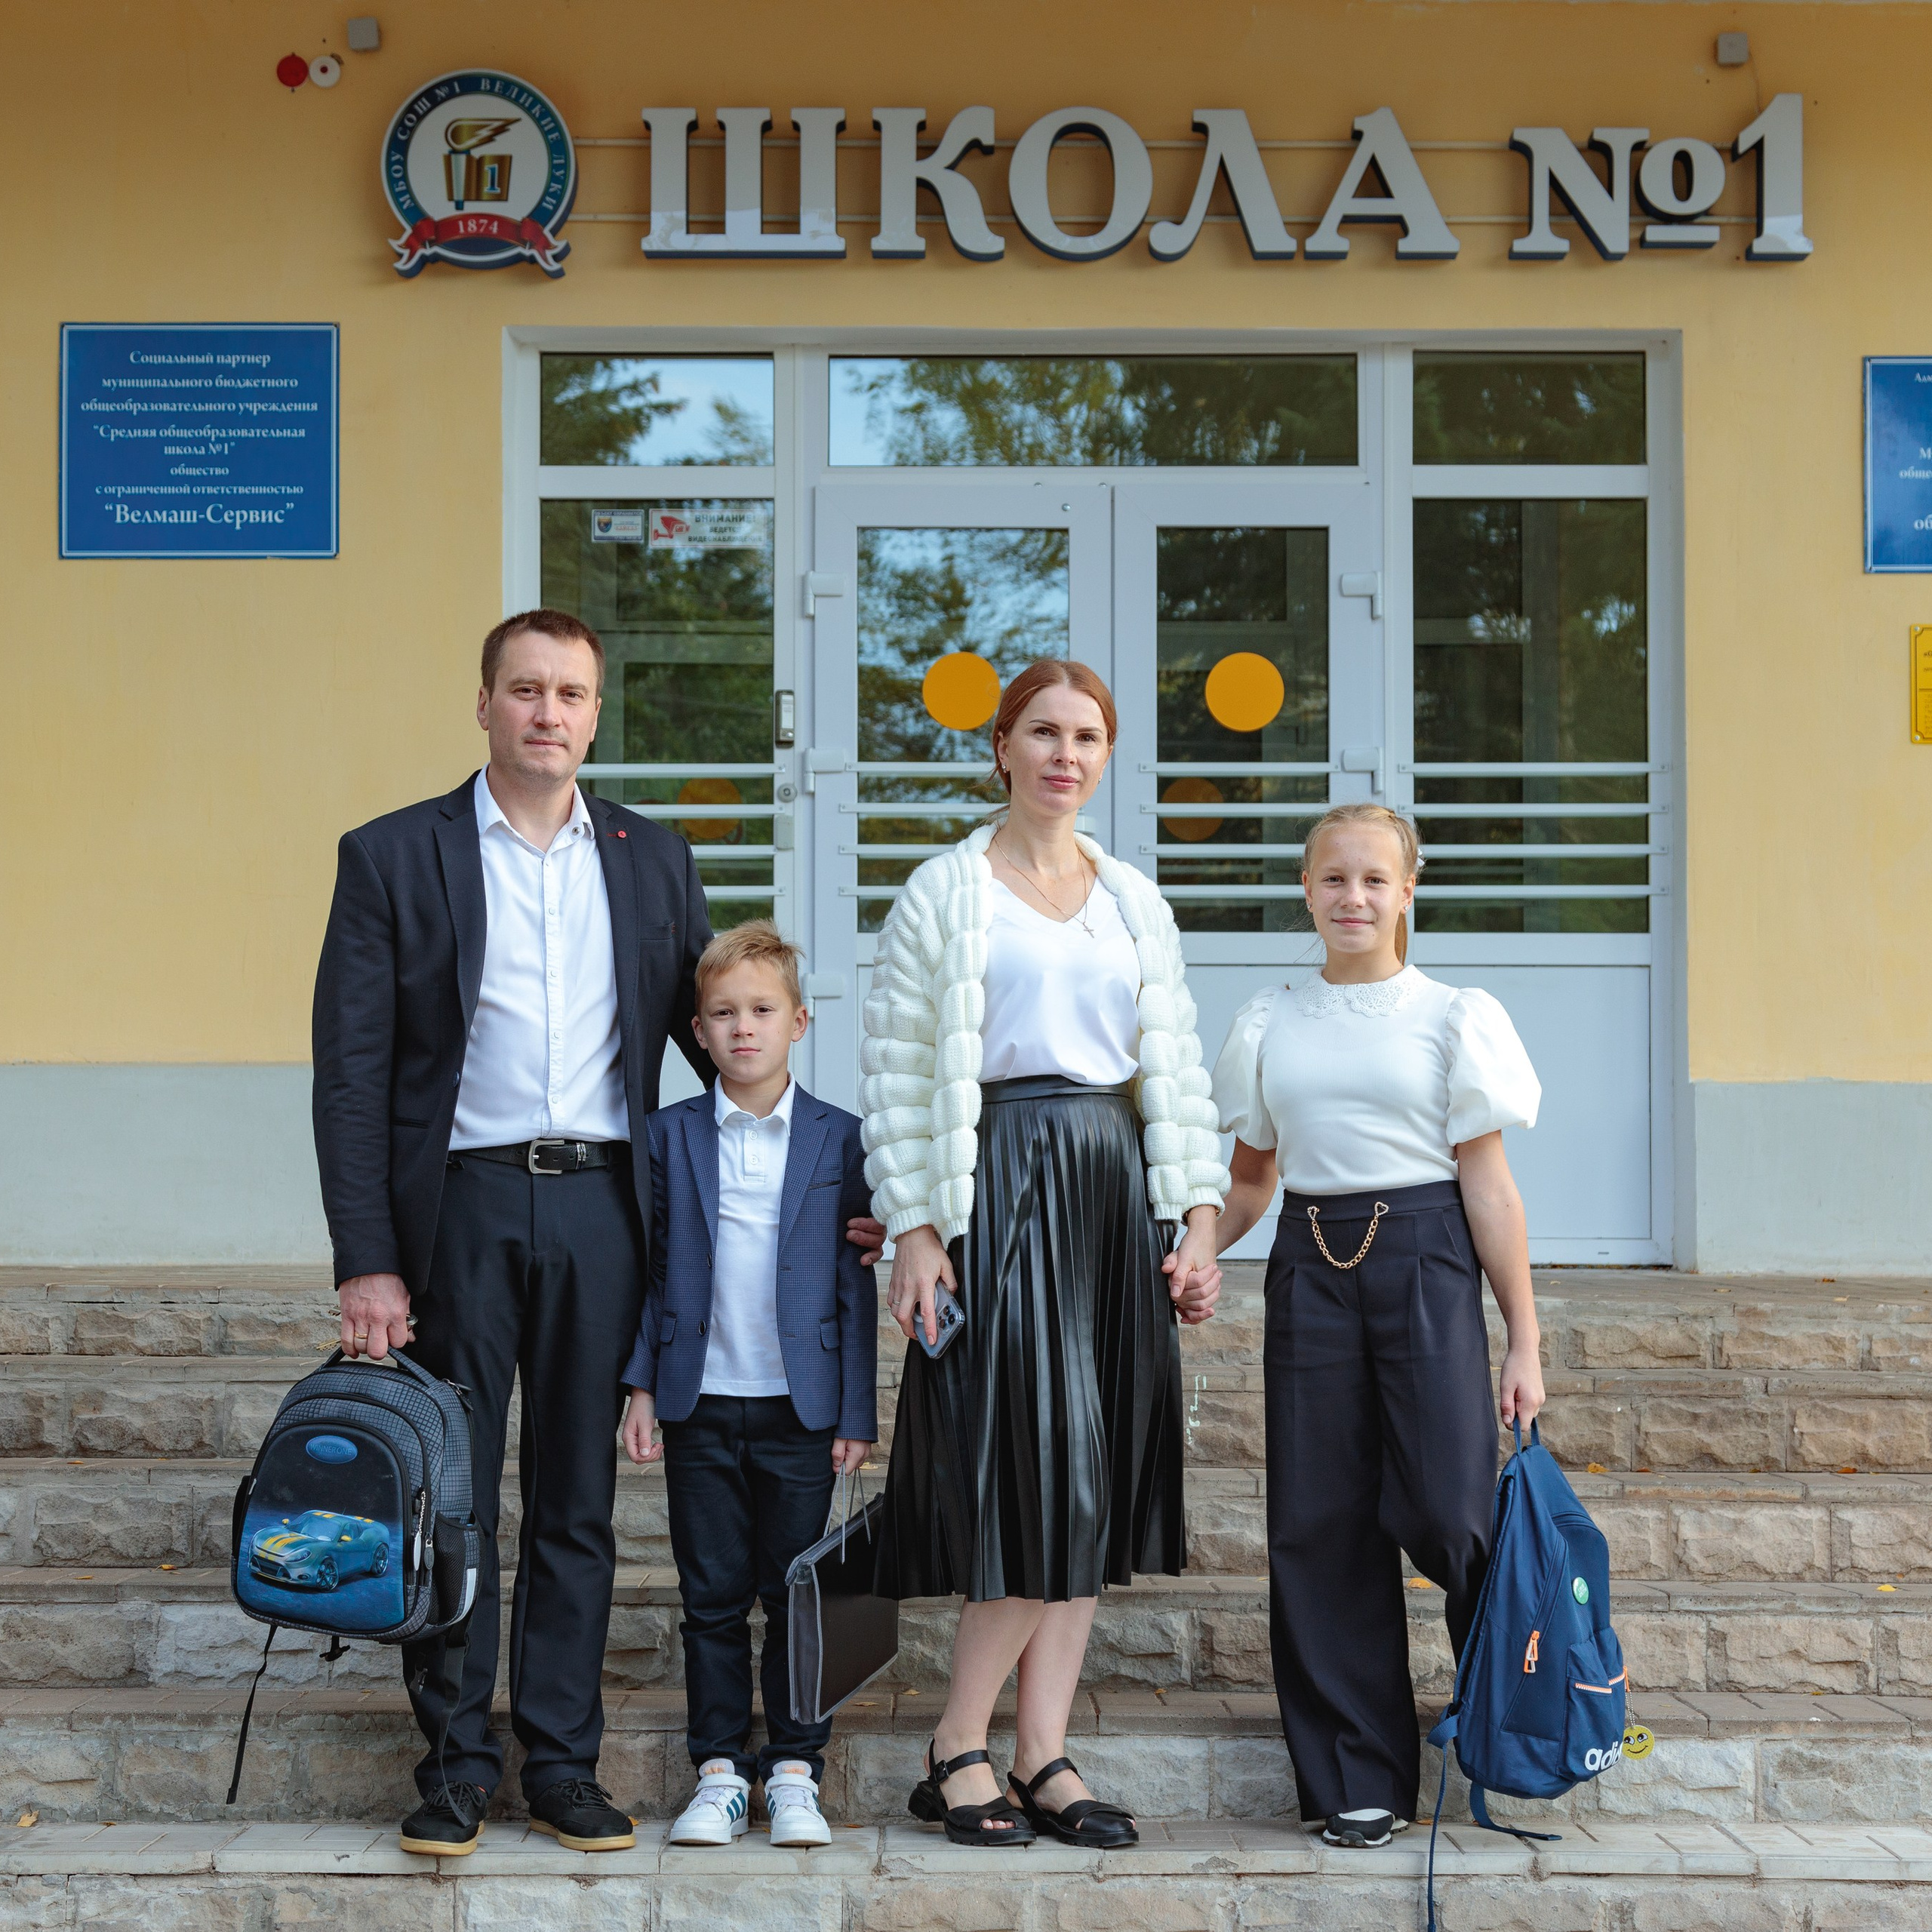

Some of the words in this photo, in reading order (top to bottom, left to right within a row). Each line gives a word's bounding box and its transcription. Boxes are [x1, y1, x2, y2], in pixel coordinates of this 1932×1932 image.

[480, 78, 561, 143] ВЕЛИКИЕ
[397, 99, 432, 141] СОШ
[390, 150, 414, 210] МБОУ
[485, 163, 501, 193] 1
[542, 153, 565, 211] ЛУКИ
[641, 106, 1460, 260] ШКОЛА
[457, 219, 499, 234] 1874
[129, 350, 214, 365] Социальный
[217, 353, 271, 368] партнер
[102, 377, 213, 391] муниципального
[215, 374, 299, 389] бюджетного
[81, 398, 236, 416] общеобразовательного
[238, 401, 318, 416] учреждения
[158, 424, 306, 441] общеобразовательная
[164, 445, 205, 455] школа
[170, 463, 229, 476] общество
[95, 486, 102, 494] с
[104, 484, 191, 497] ограниченной
[192, 485, 303, 495] ответственностью
[104, 502, 294, 530] “Велмаш-Сервис”
[694, 514, 755, 523] ВНИМАНИЕ!
